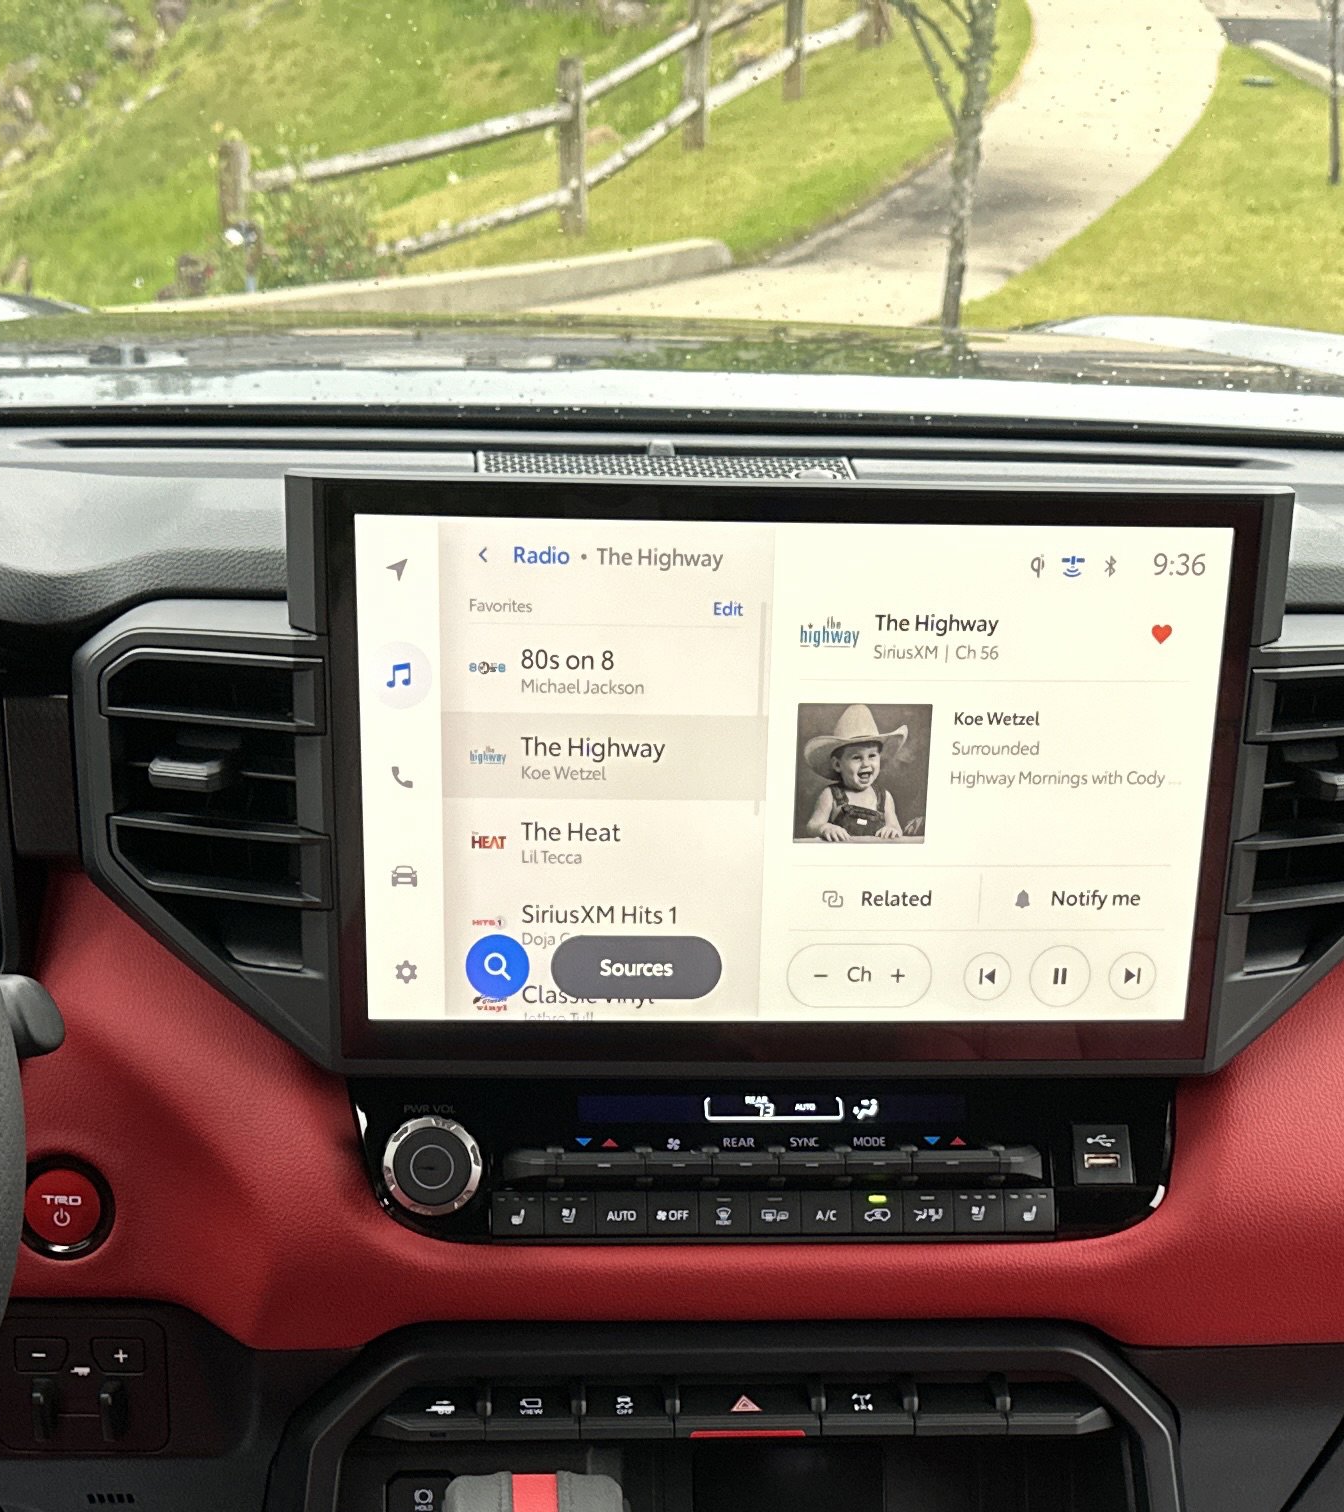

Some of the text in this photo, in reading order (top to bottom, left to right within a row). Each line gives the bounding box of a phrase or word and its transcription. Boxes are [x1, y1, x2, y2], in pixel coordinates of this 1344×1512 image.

[513, 547, 724, 571] Radio The Highway
[1153, 553, 1207, 577] 9:36
[468, 599, 533, 614] Favorites
[713, 601, 744, 618] Edit
[875, 614, 999, 637] The Highway
[799, 622, 860, 648] highway
[521, 649, 560, 671] 80s
[566, 654, 595, 671] on
[601, 650, 615, 671] 8
[873, 644, 999, 661] SiriusXM Ch 56
[521, 679, 645, 696] Michael Jackson
[954, 711, 1040, 727] Koe Wetzel
[521, 736, 666, 763] The Highway
[951, 740, 1040, 757] Surrounded
[521, 766, 607, 781] Koe Wetzel
[950, 770, 1166, 788] Highway Mornings with Cody
[521, 821, 621, 843] The Heat
[471, 835, 507, 850] HEAT
[521, 850, 583, 865] Lil Tecca
[861, 890, 932, 908] Related
[1050, 890, 1141, 911] Notify me
[521, 904, 677, 925] SiriusXM Hits 1
[522, 932, 556, 949] Doja
[600, 958, 674, 977] Sources
[847, 966, 872, 983] Ch
[722, 1137, 755, 1148] REAR
[789, 1136, 820, 1147] SYNC
[853, 1136, 886, 1147] MODE
[41, 1194, 82, 1206] TRD
[606, 1210, 637, 1222] AUTO
[668, 1210, 690, 1222] OFF
[815, 1209, 837, 1222] A/C
